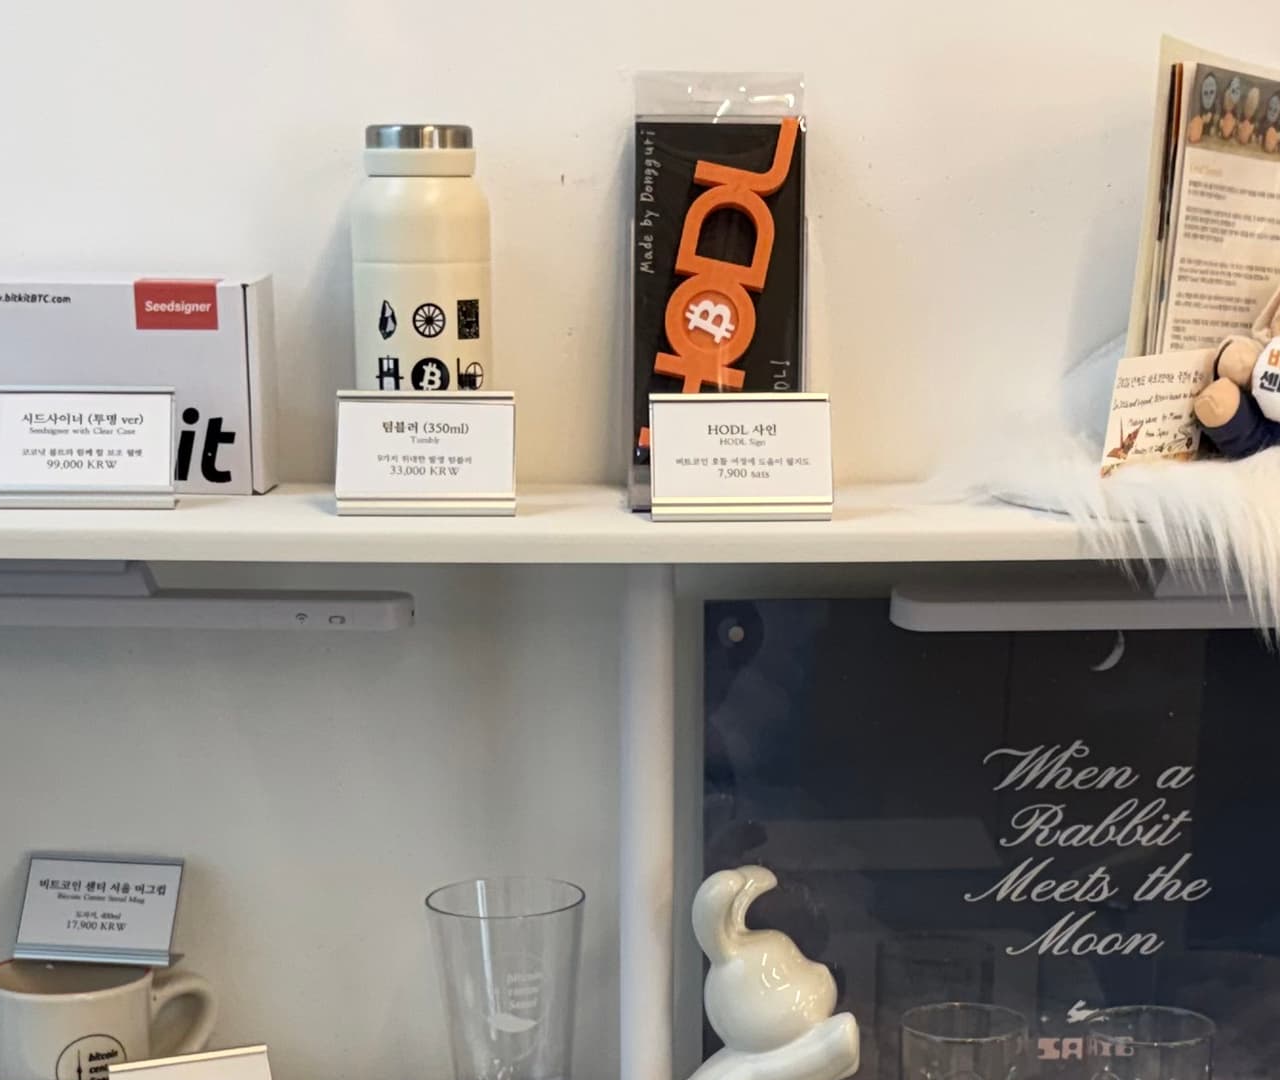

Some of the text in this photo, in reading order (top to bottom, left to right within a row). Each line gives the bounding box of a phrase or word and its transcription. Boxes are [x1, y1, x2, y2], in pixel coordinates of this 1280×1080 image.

[639, 129, 662, 275] Made by Dongguri
[144, 300, 212, 314] Seedsigner
[22, 413, 144, 425] 시드사이너 (투명 ver)
[29, 427, 136, 435] Seedsigner with Clear Case
[382, 420, 469, 434] 텀블러 (350ml)
[707, 424, 777, 436] HODL 사인
[719, 438, 766, 447] HODL Sign
[46, 459, 118, 470] 99,000 KRW
[390, 465, 459, 476] 33,000 KRW
[718, 468, 770, 479] 7,900 sats
[982, 738, 1195, 794] When a
[1000, 798, 1192, 850] Rabbit
[964, 851, 1213, 905] Meets the
[39, 879, 167, 896] 비트코인 센터 서울 머그컵
[66, 919, 127, 932] 17,900 KRW
[1006, 911, 1165, 957] Moon
[88, 1049, 119, 1062] bitcoin
